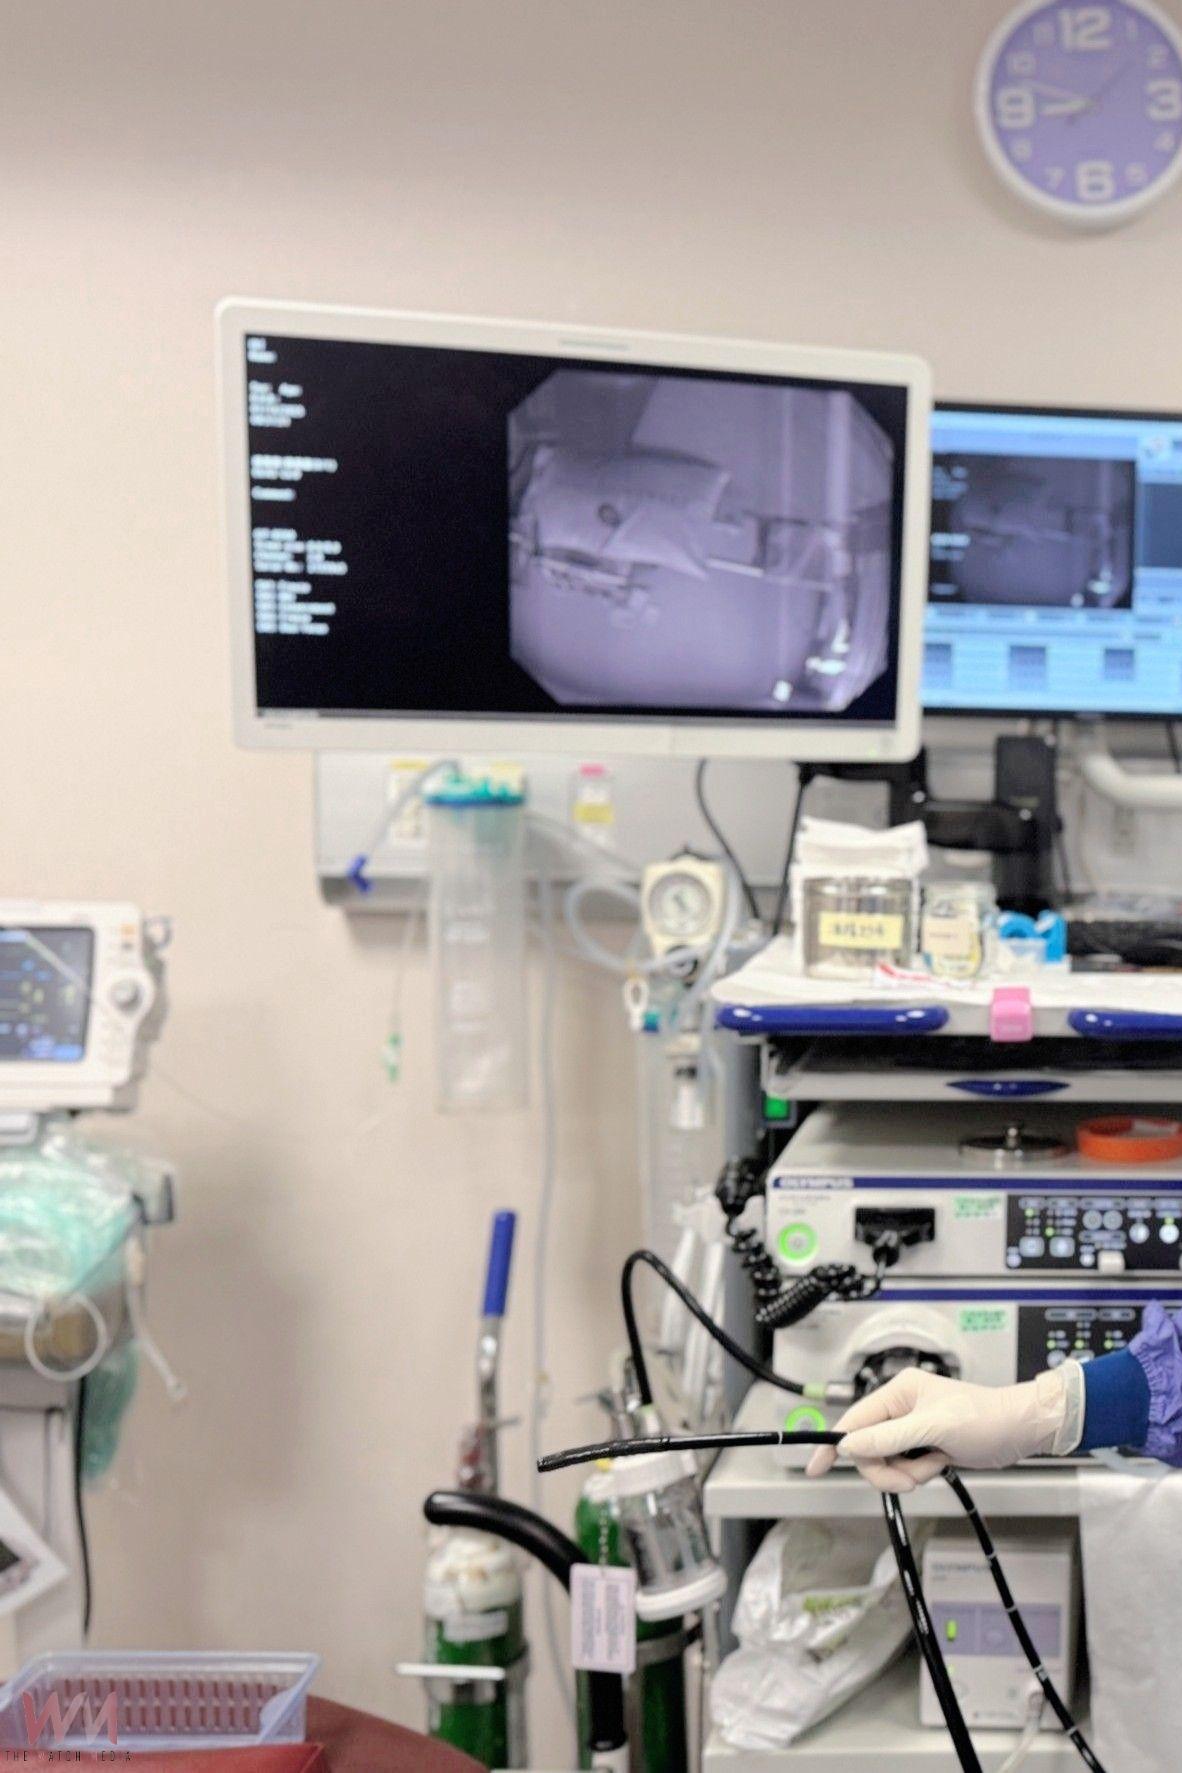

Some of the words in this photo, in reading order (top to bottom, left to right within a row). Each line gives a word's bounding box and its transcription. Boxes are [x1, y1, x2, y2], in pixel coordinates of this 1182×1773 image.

[1057, 7, 1112, 50] 12
[997, 86, 1034, 129] 9
[1146, 79, 1182, 121] 3
[1045, 166, 1065, 190] 7
[1075, 160, 1115, 200] 6
